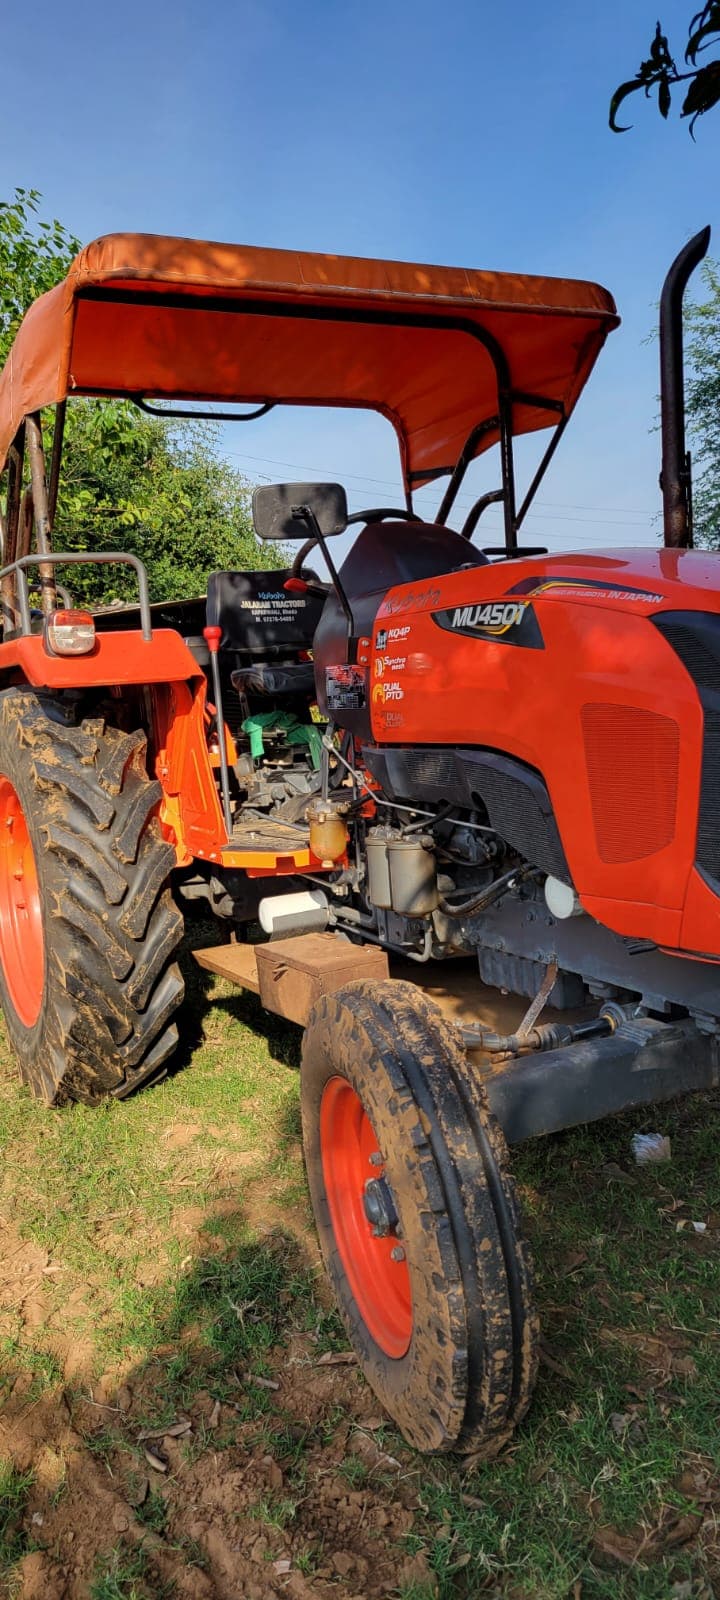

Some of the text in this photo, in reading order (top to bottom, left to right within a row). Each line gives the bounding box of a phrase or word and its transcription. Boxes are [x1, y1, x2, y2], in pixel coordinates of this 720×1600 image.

[607, 591, 619, 599] IN
[618, 591, 664, 603] JAPAN
[272, 600, 306, 609] TRACTORS
[384, 656, 406, 666] Synchro
[383, 682, 402, 692] DUAL
